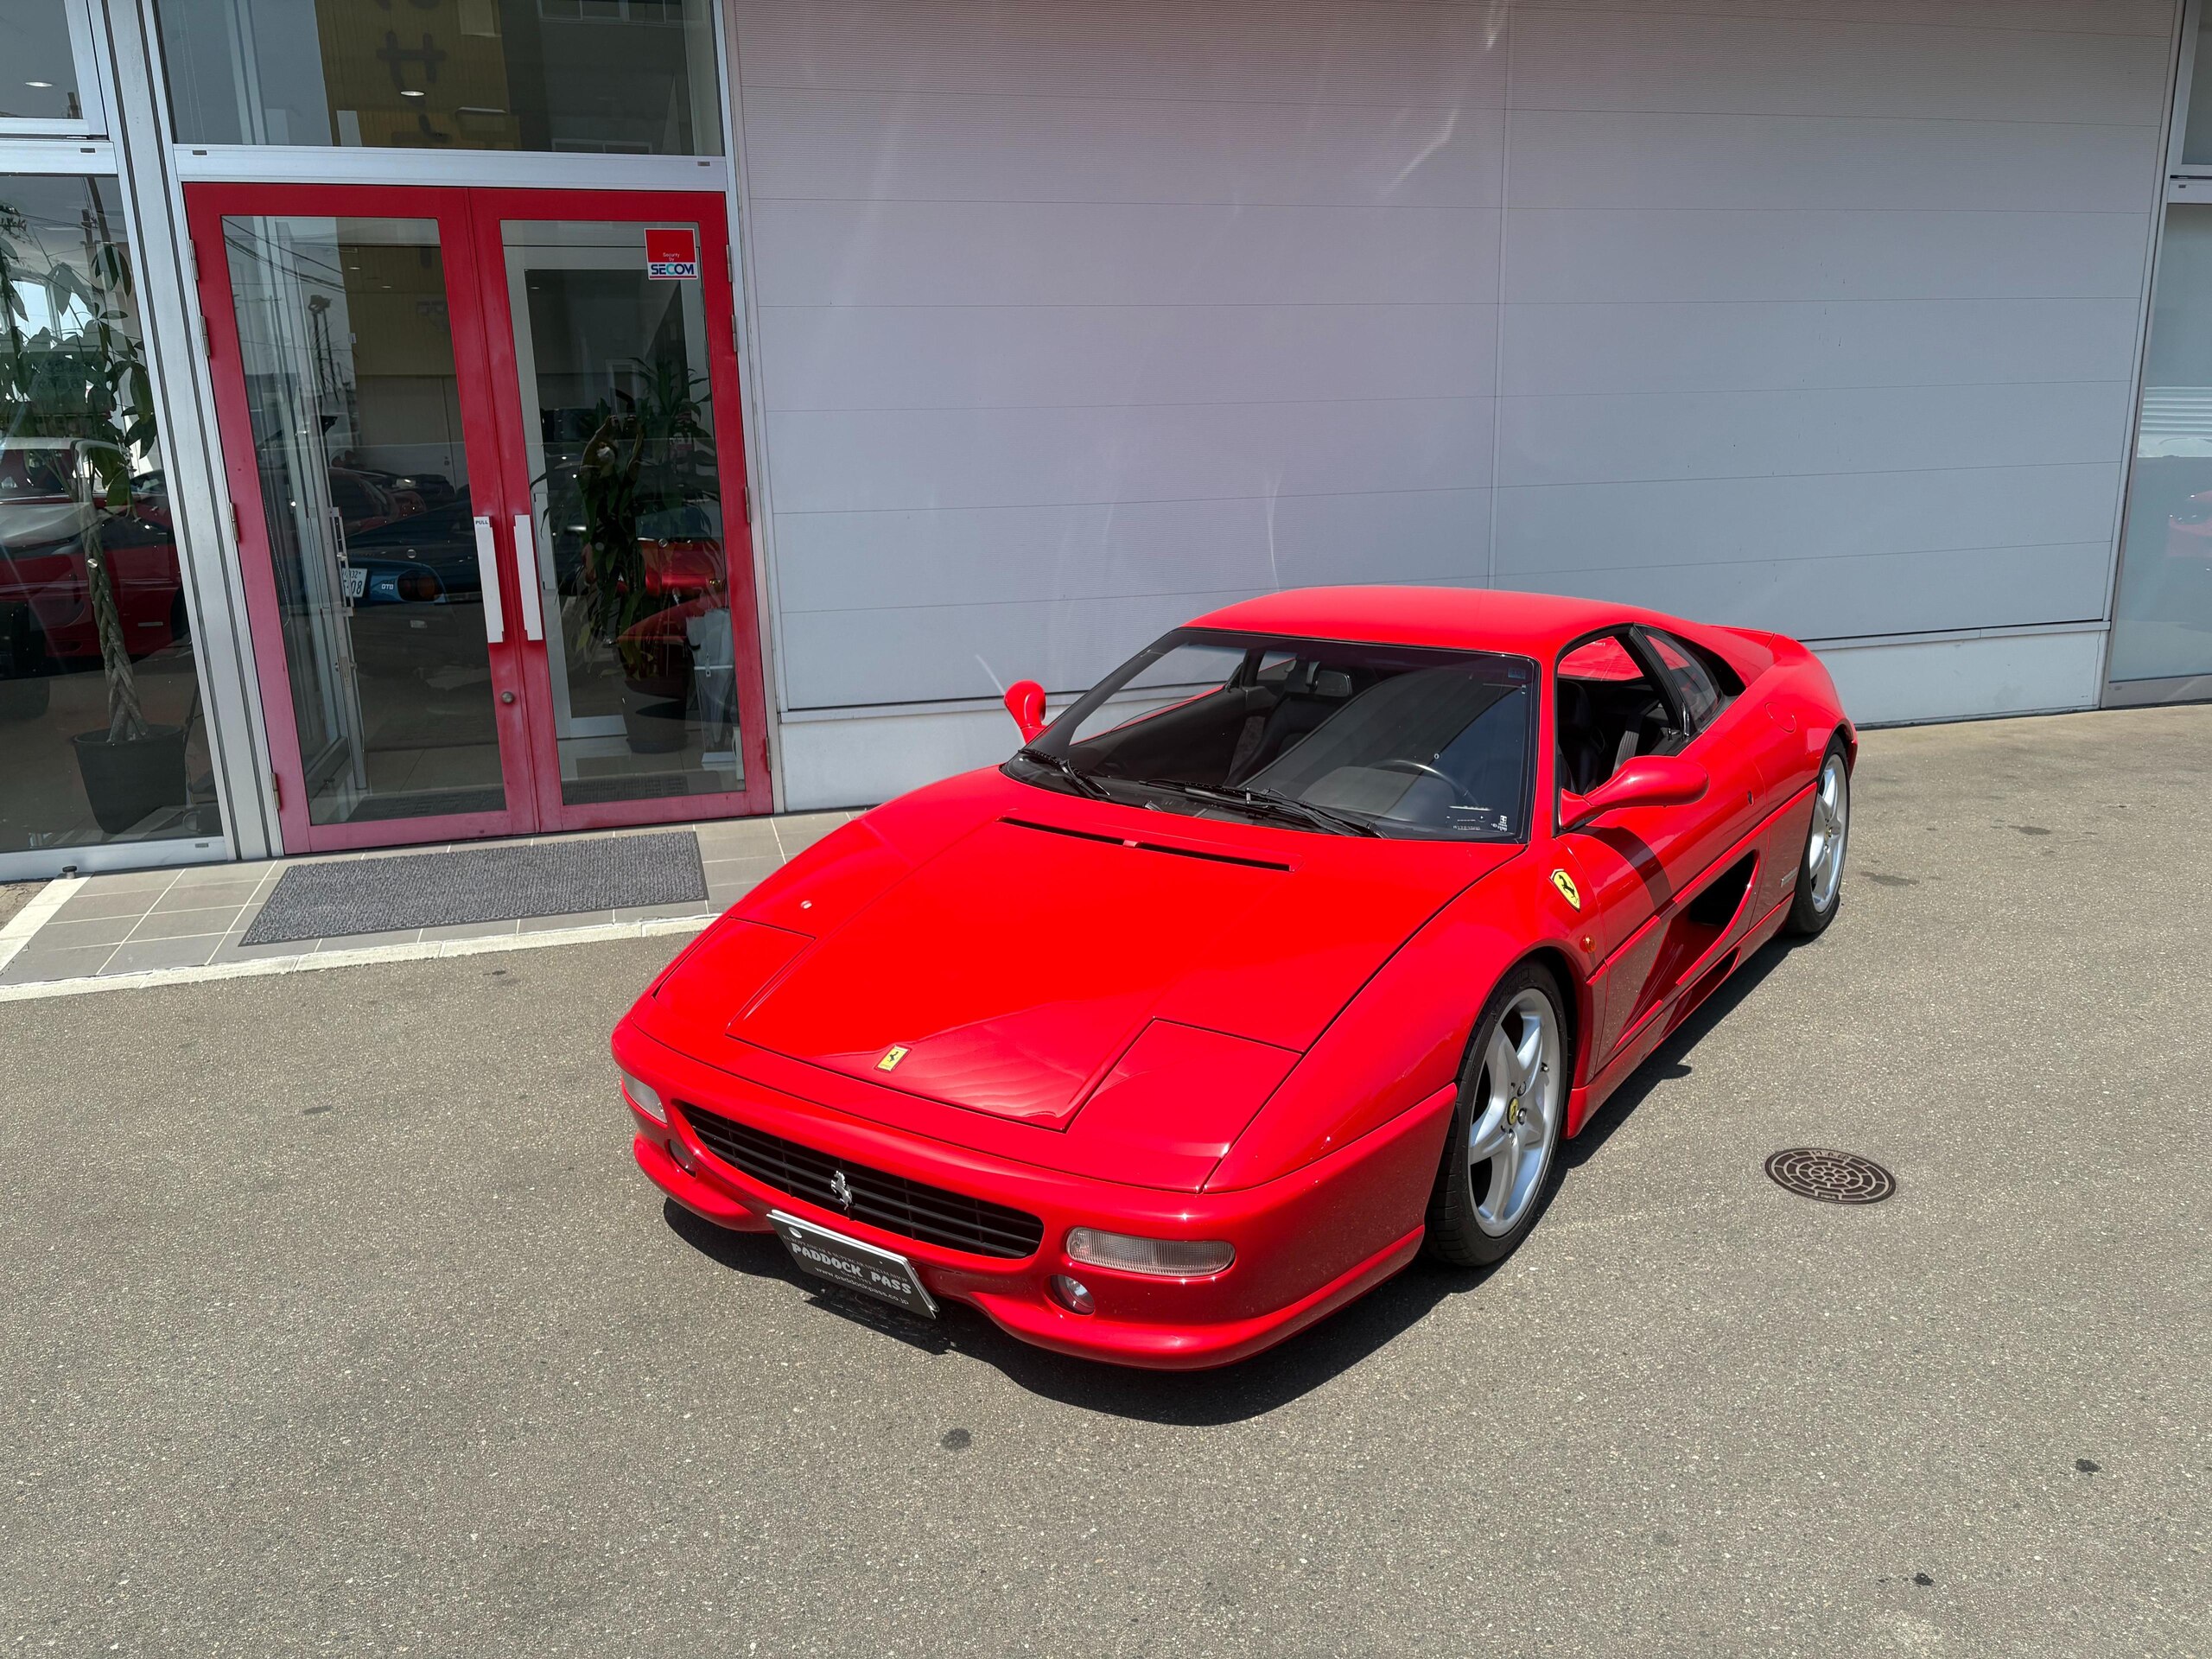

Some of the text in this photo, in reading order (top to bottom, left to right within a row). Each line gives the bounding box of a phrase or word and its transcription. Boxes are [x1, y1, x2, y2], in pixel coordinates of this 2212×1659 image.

[651, 264, 695, 275] SECOM
[791, 1243, 863, 1278] PADDOCK
[870, 1271, 912, 1294] PASS
